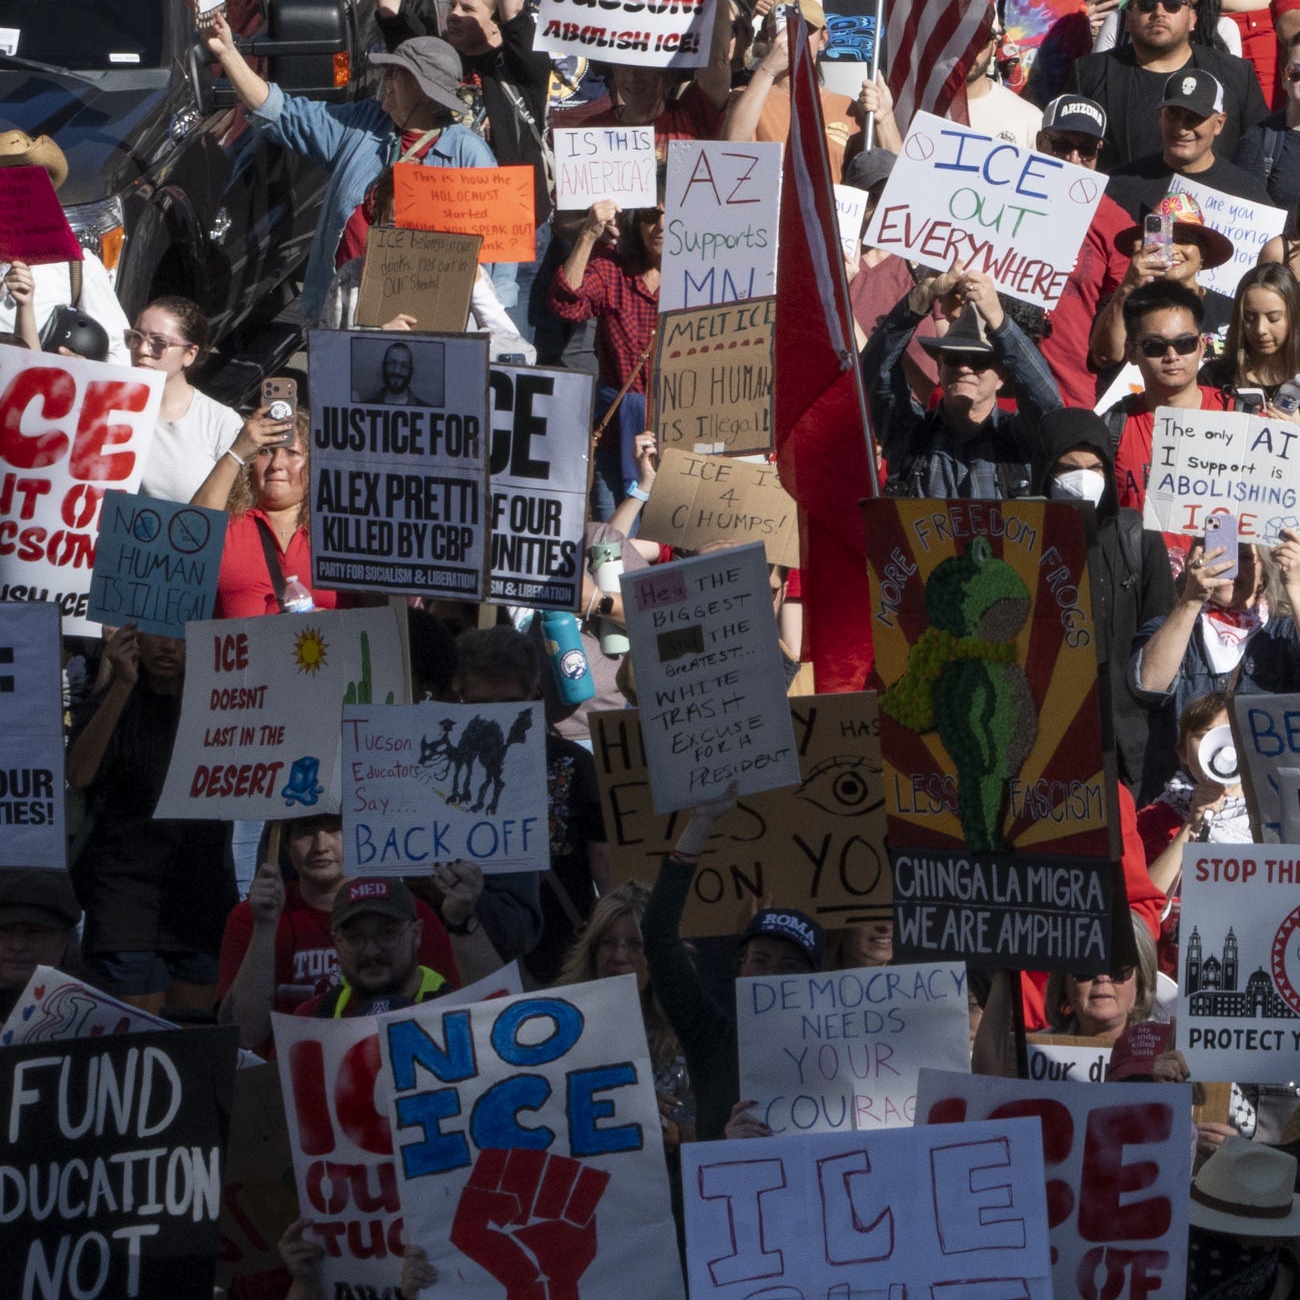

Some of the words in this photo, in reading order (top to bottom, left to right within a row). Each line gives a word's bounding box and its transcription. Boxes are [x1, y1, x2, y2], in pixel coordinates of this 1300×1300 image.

[934, 130, 1063, 199] ICE
[949, 188, 1047, 237] OUT
[877, 205, 1071, 300] EVERYWHERE
[315, 406, 424, 454] JUSTICE
[430, 413, 479, 457] FOR
[316, 468, 380, 517] ALEX
[386, 475, 479, 524] PRETTI
[323, 516, 393, 556] KILLED
[398, 522, 427, 559] BY
[432, 525, 473, 562] CBP
[895, 857, 988, 901] CHINGA
[991, 863, 1021, 902] LA
[1027, 865, 1104, 910] MIGRA
[1196, 860, 1257, 884] STOP
[387, 997, 584, 1093] NO
[1189, 1031, 1285, 1052] PROTECT
[395, 1061, 643, 1180] ICE
